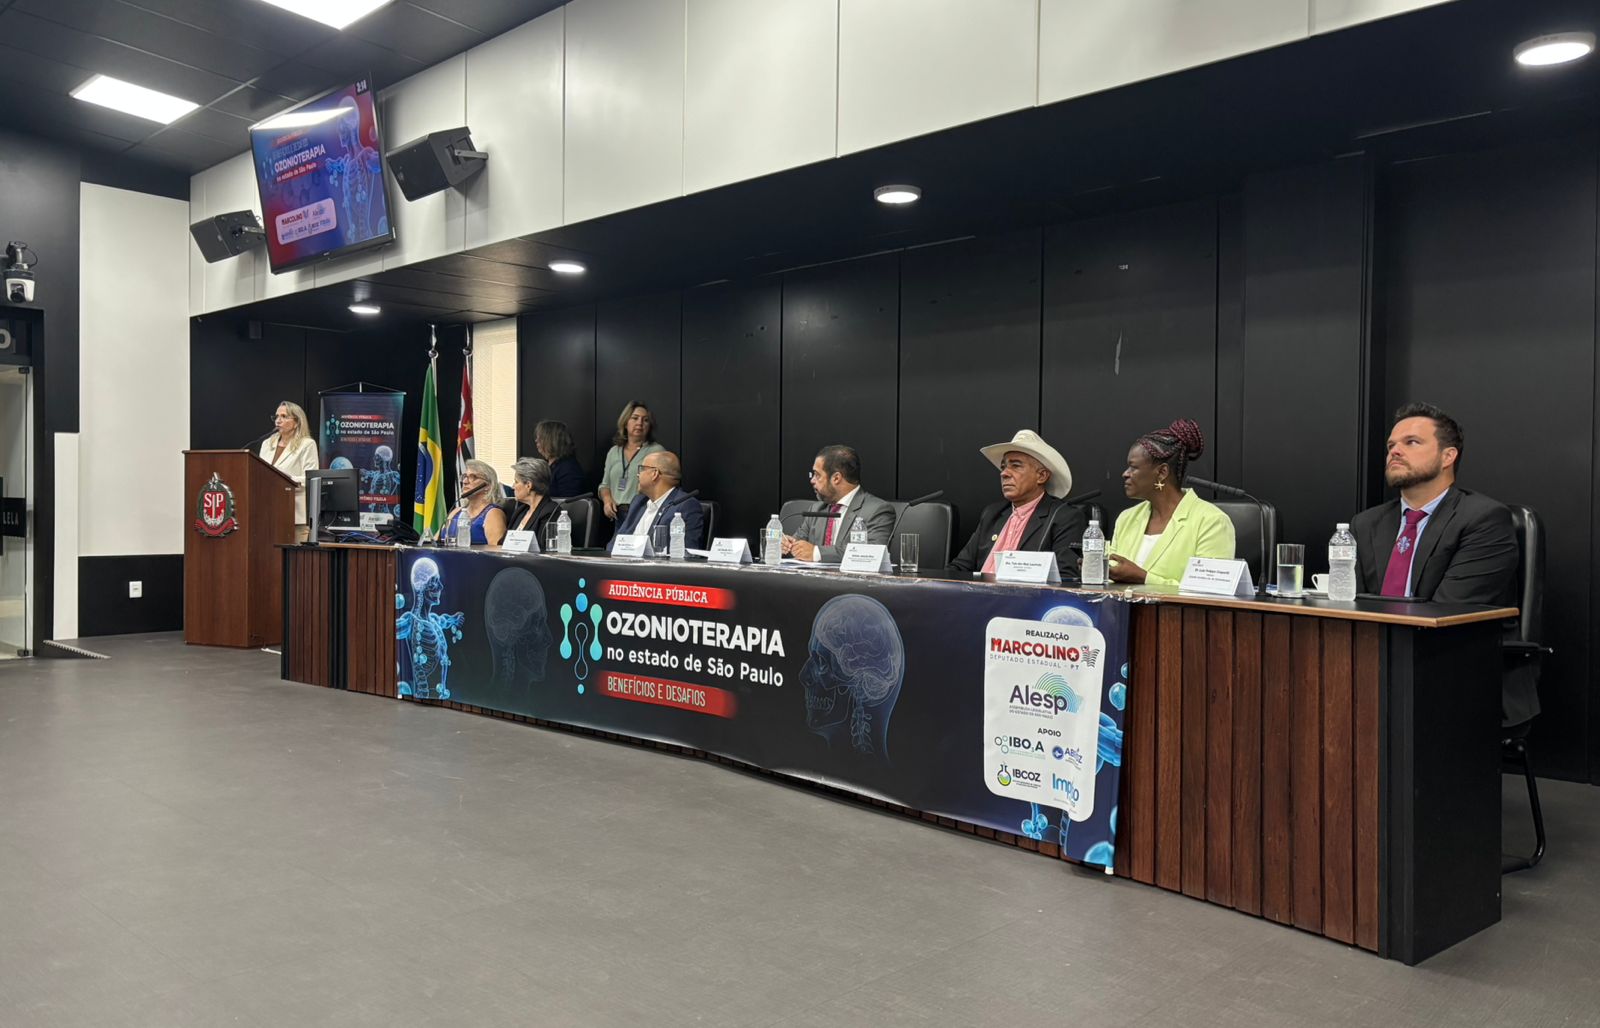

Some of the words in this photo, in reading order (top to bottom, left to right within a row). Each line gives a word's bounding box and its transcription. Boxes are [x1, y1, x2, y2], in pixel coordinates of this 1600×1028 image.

[274, 143, 326, 173] OZONIOTERAPIA
[340, 421, 395, 430] OZONIOTERAPIA
[608, 584, 664, 600] AUDIÊNCIA
[665, 587, 709, 604] PÚBLICA
[606, 611, 786, 657] OZONIOTERAPIA
[1025, 629, 1070, 641] REALIZAÇÃO
[990, 637, 1080, 662] MARCOLINO
[607, 646, 624, 661] no
[628, 649, 679, 669] estado
[683, 653, 702, 673] de
[707, 657, 734, 678] São
[740, 662, 784, 687] Paulo
[990, 654, 1025, 663] DEPUTADO
[1027, 659, 1062, 669] ESTADUAL
[607, 675, 656, 699] BENEFÍCIOS
[658, 683, 664, 699] E
[665, 684, 706, 707] DESAFIOS
[1009, 684, 1068, 715] Alesp
[1037, 727, 1062, 737] APOIO
[1012, 768, 1041, 782] IBCOZ
